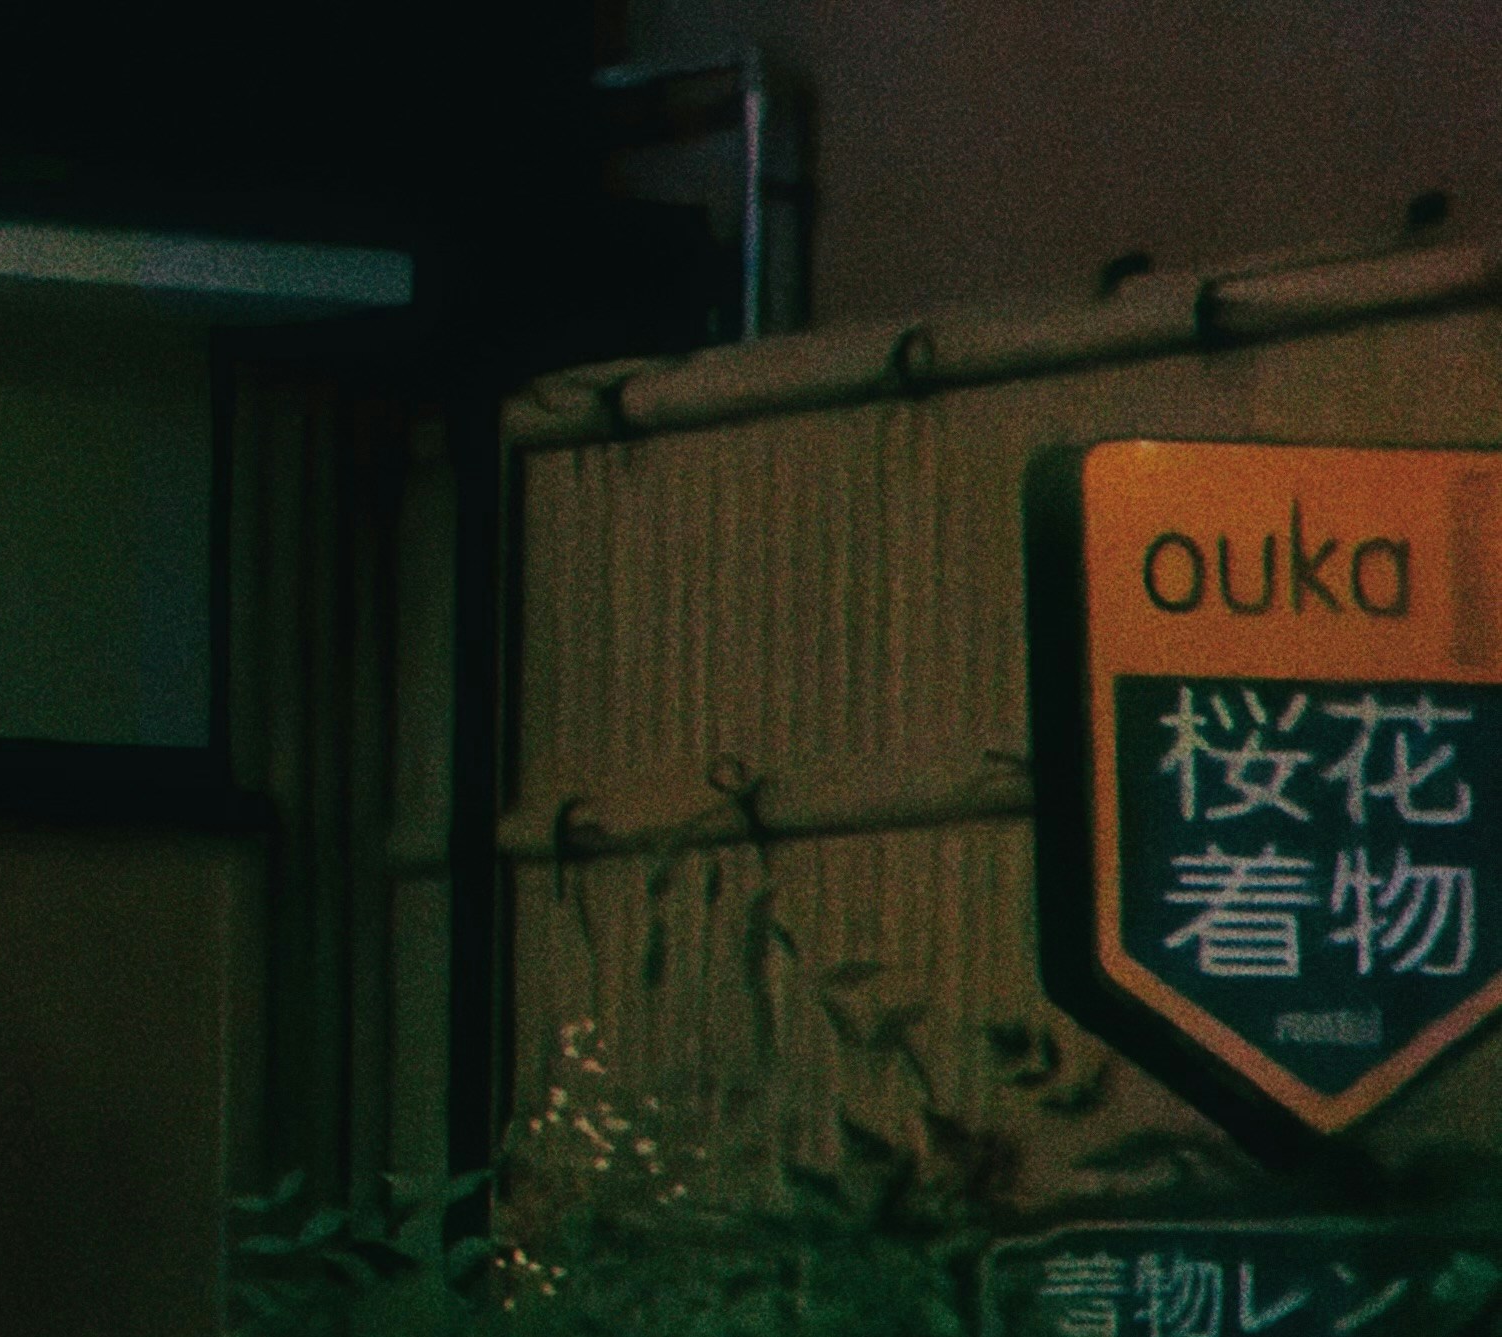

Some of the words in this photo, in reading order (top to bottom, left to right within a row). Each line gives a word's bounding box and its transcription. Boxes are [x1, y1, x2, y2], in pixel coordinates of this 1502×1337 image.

[1143, 500, 1410, 618] ouka
[1159, 687, 1474, 824] 桜花
[1162, 845, 1474, 978] 着物
